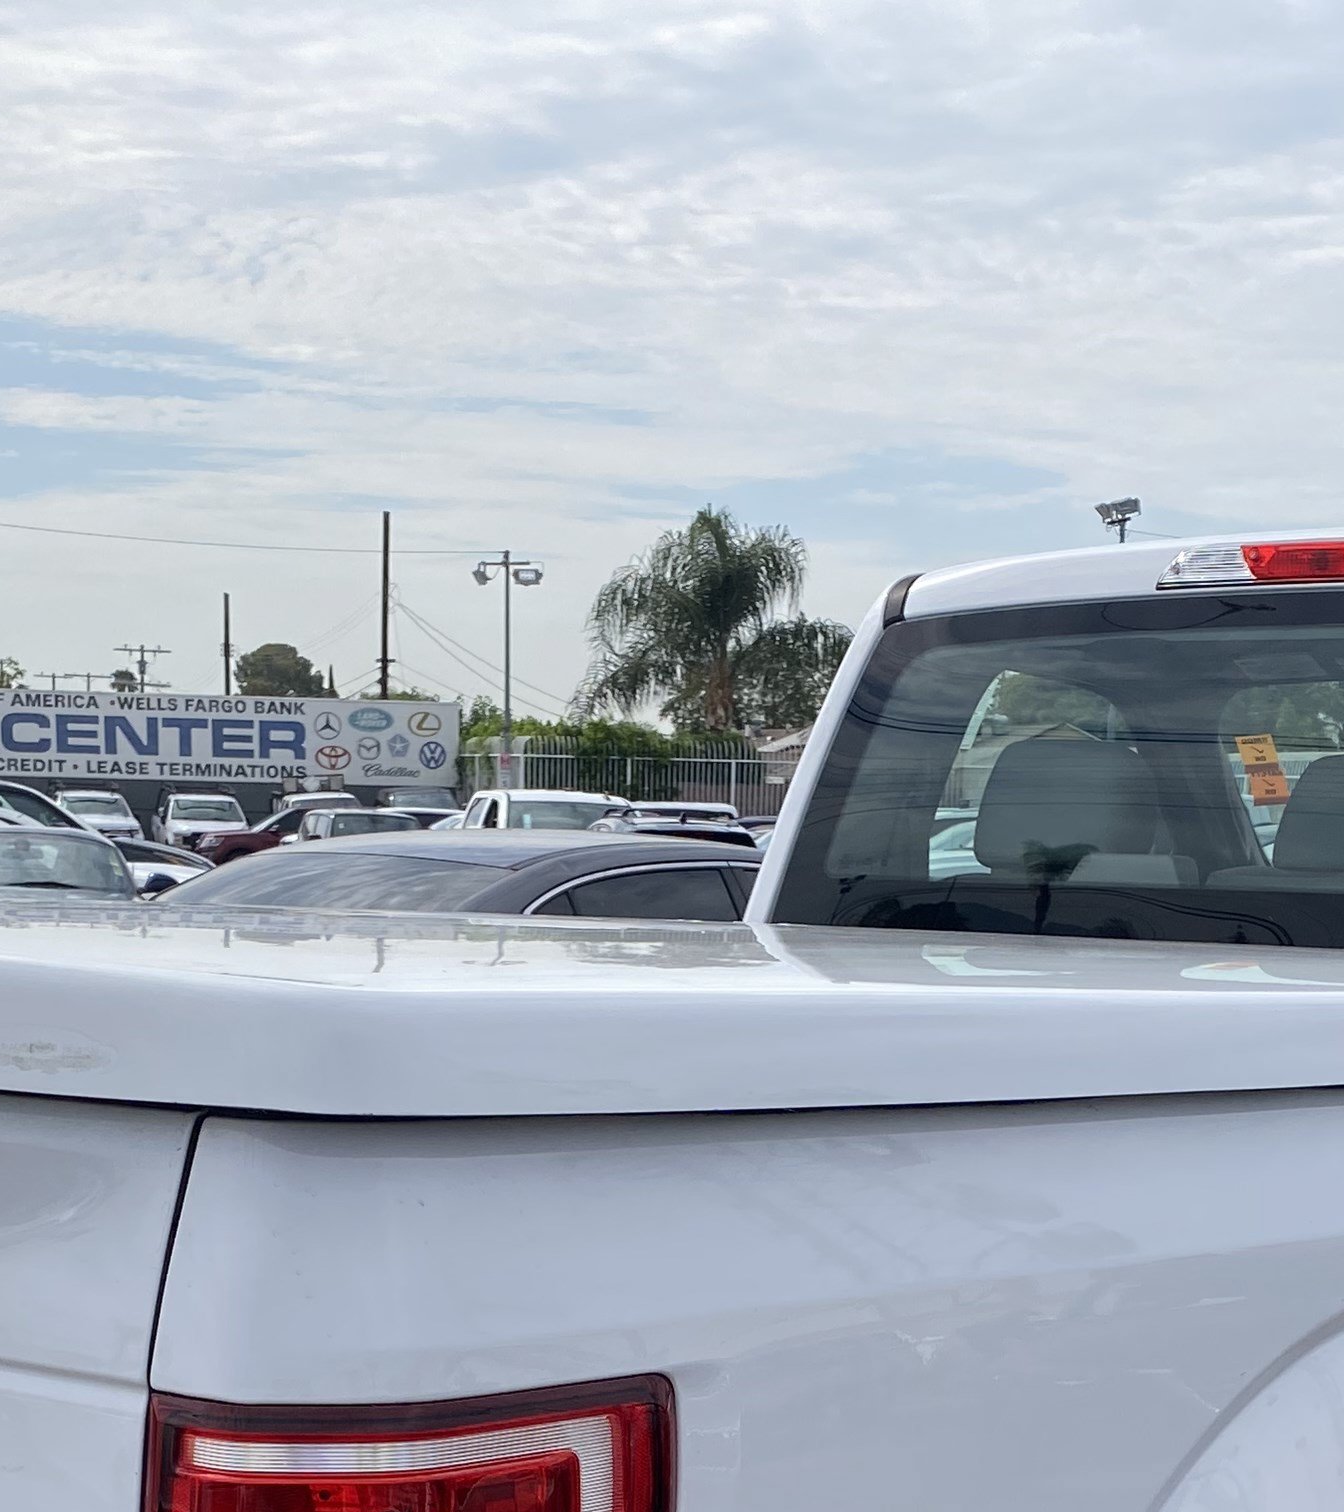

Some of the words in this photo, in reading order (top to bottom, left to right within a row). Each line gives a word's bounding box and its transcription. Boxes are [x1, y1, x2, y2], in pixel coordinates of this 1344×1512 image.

[10, 693, 99, 709] AMERICA
[117, 696, 178, 711] WELLS
[184, 698, 246, 714] FARGO
[254, 700, 306, 715] BANK
[0, 712, 306, 760] CENTER
[86, 760, 149, 775] LEASE
[156, 763, 307, 779] TERMINATIONS
[362, 763, 421, 778] Cadillac
